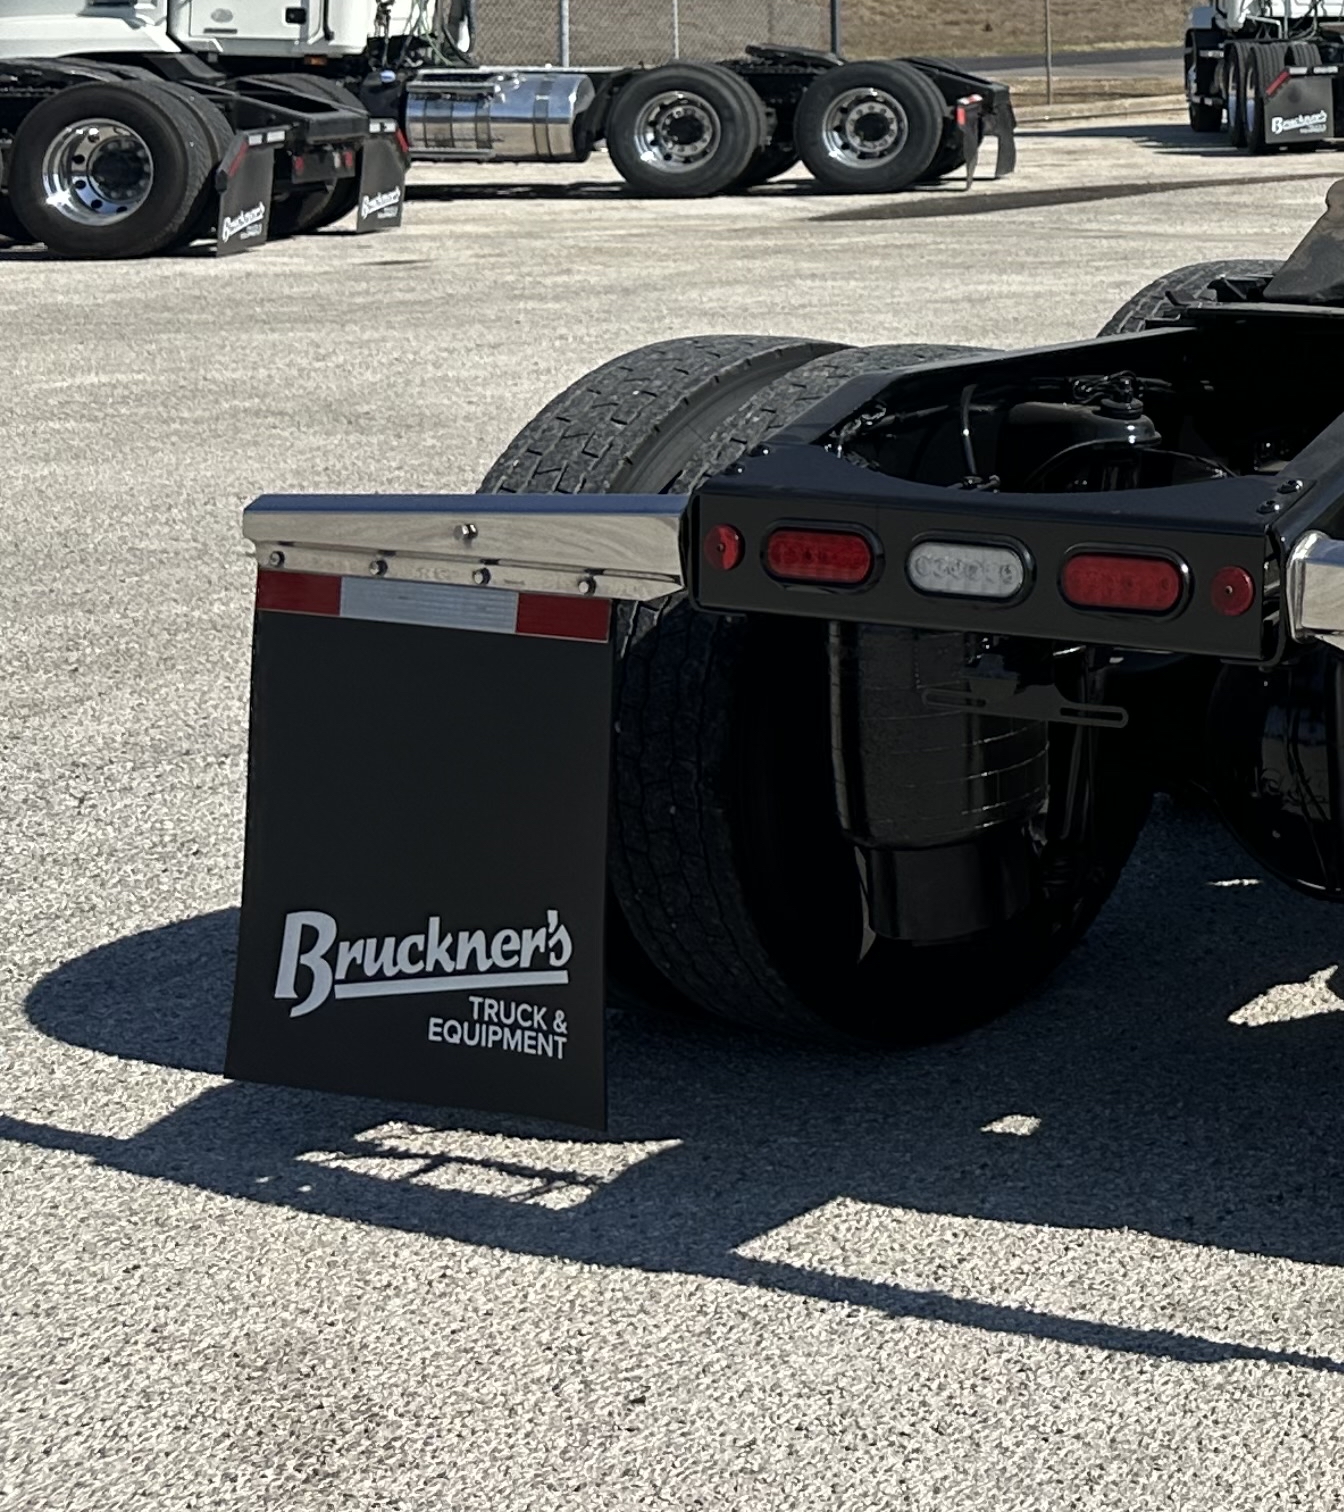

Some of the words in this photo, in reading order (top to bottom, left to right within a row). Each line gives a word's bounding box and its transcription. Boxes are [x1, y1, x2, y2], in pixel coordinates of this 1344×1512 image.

[274, 909, 573, 1018] Bruckner's
[468, 995, 548, 1030] TRUCK
[553, 1010, 568, 1034] &
[428, 1017, 568, 1059] EQUIPMENT
